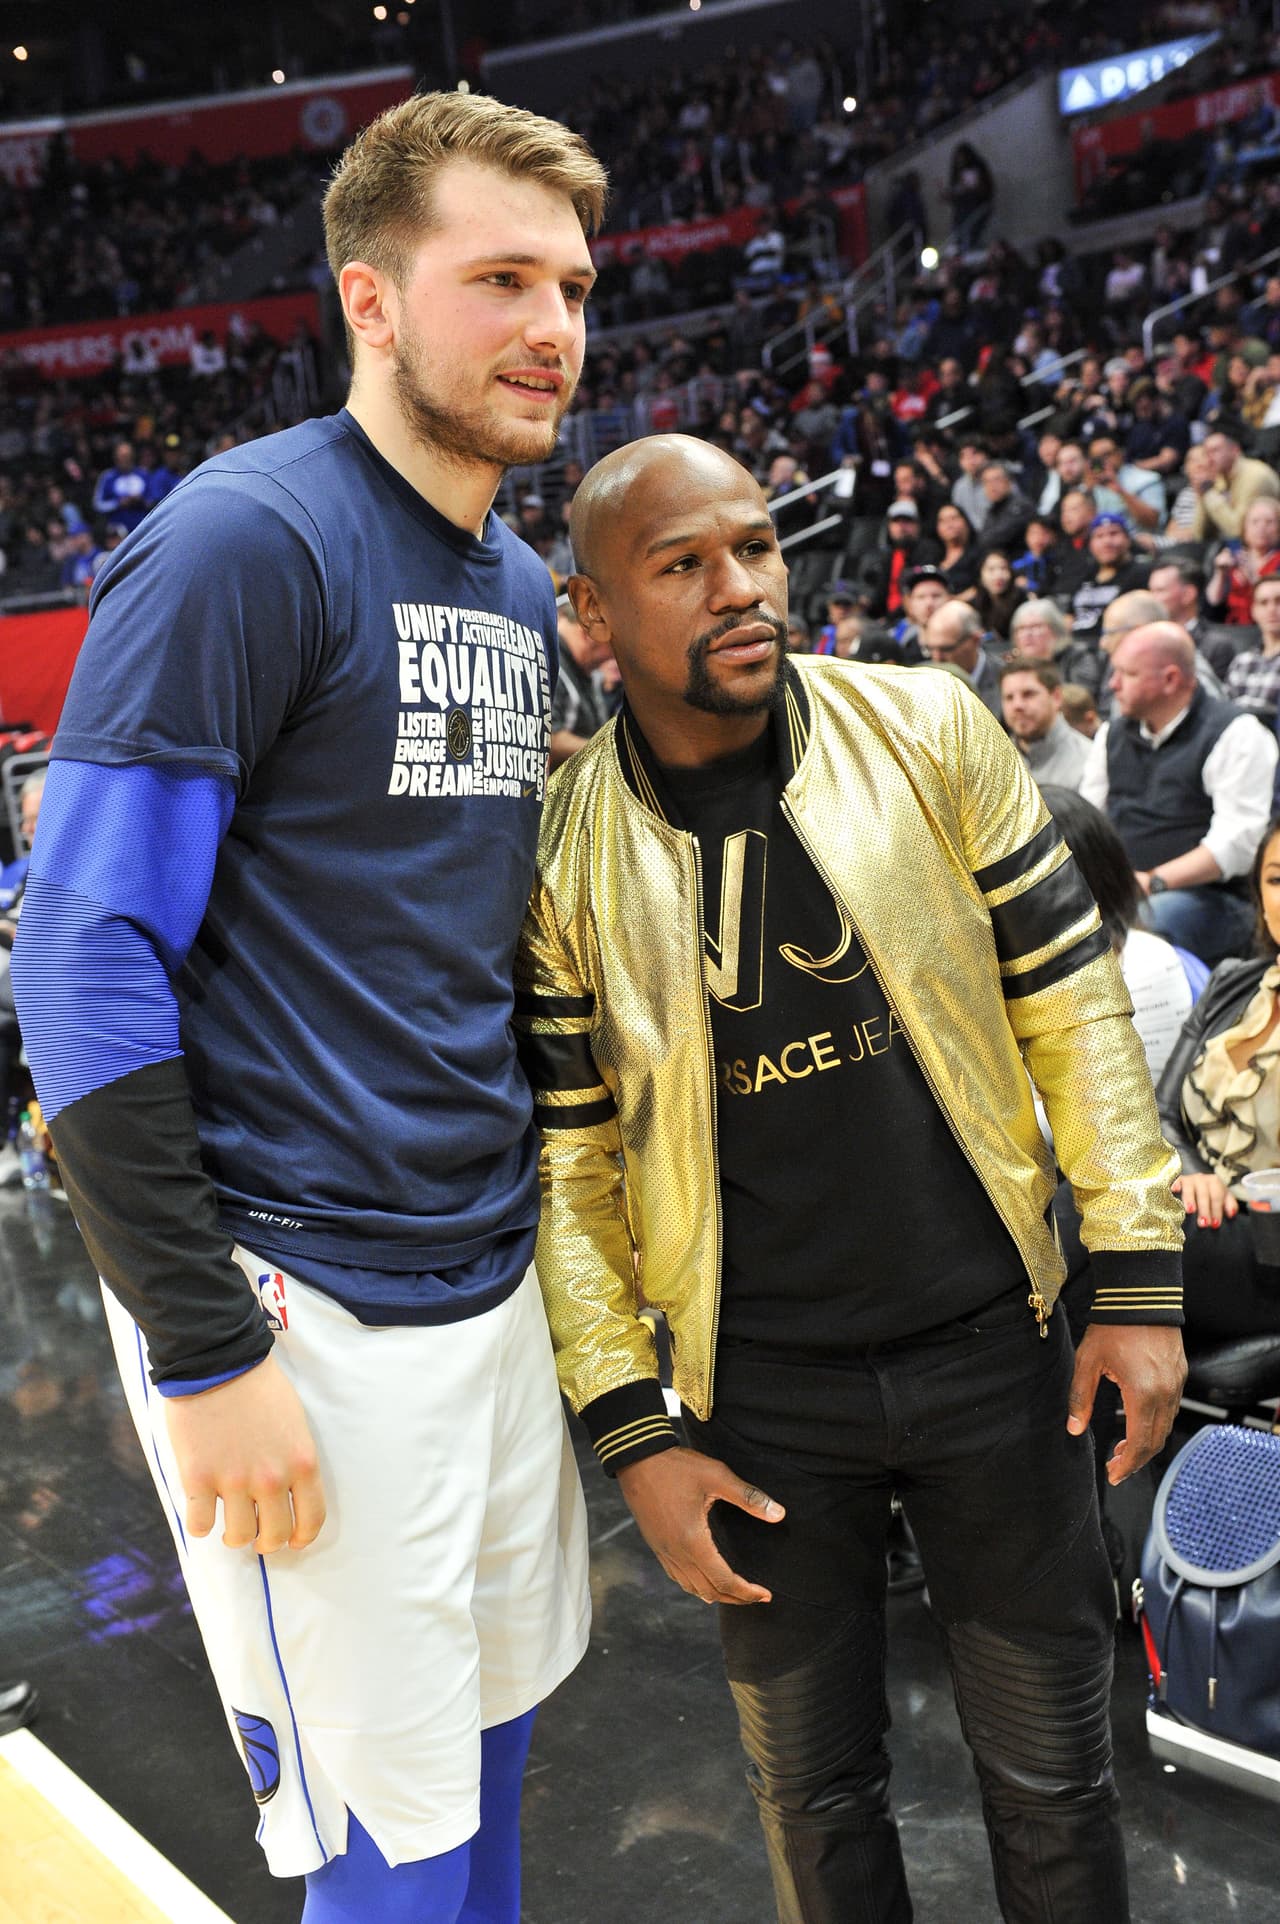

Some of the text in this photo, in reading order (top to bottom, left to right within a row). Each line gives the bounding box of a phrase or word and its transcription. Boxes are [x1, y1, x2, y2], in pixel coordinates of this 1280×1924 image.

[392, 603, 459, 643] UNIFY
[462, 622, 506, 650] ACTIVATE
[503, 616, 536, 660] LEAD
[398, 641, 538, 717] EQUALITY
[532, 630, 552, 749] BELIEVE
[398, 712, 446, 737] LISTEN
[484, 708, 542, 750] HISTORY
[394, 739, 446, 762] ENGAGE
[471, 707, 483, 795] INSPIRE
[483, 743, 537, 783] JUSTICE
[387, 763, 473, 797] DREAM
[483, 777, 521, 798] EMPOWER
[536, 752, 544, 802] LOVE
[718, 1031, 841, 1095] RSACE
[248, 1210, 304, 1229] DRI-FIT
